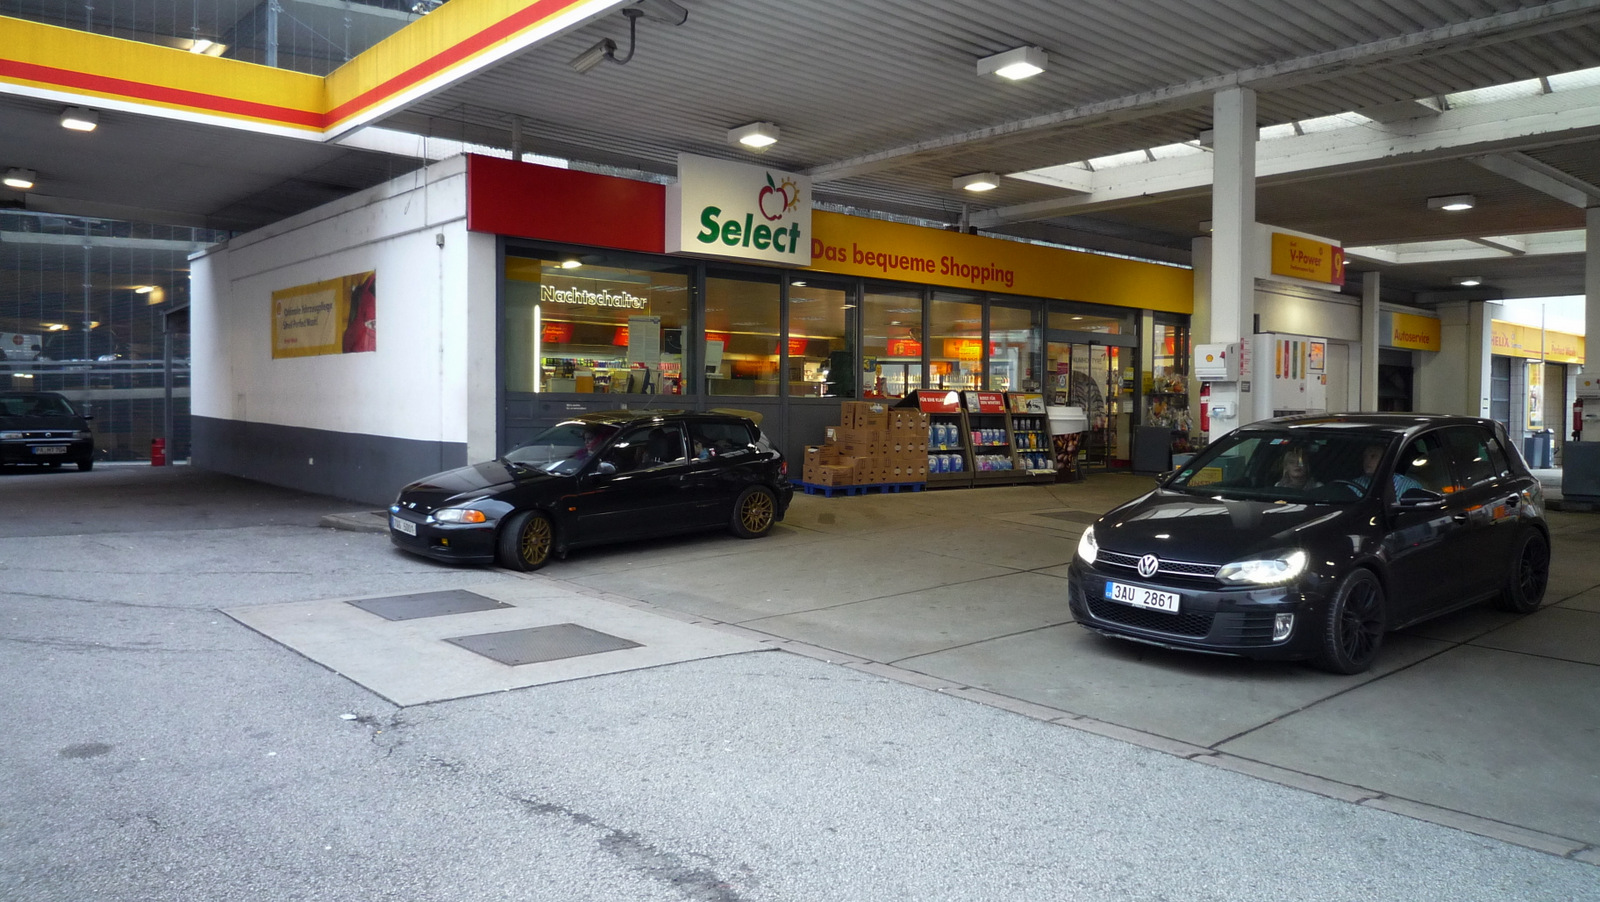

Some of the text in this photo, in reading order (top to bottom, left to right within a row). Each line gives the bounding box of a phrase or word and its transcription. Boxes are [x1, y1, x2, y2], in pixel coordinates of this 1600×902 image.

[697, 206, 800, 254] Select
[811, 238, 1014, 288] Das bequeme Shopping
[1290, 249, 1321, 266] V-Power
[1334, 253, 1342, 278] 9
[540, 284, 647, 309] Nachtschalter
[1394, 329, 1430, 344] Autoservice
[1114, 585, 1135, 601] 3AU
[1143, 591, 1173, 609] 2861
